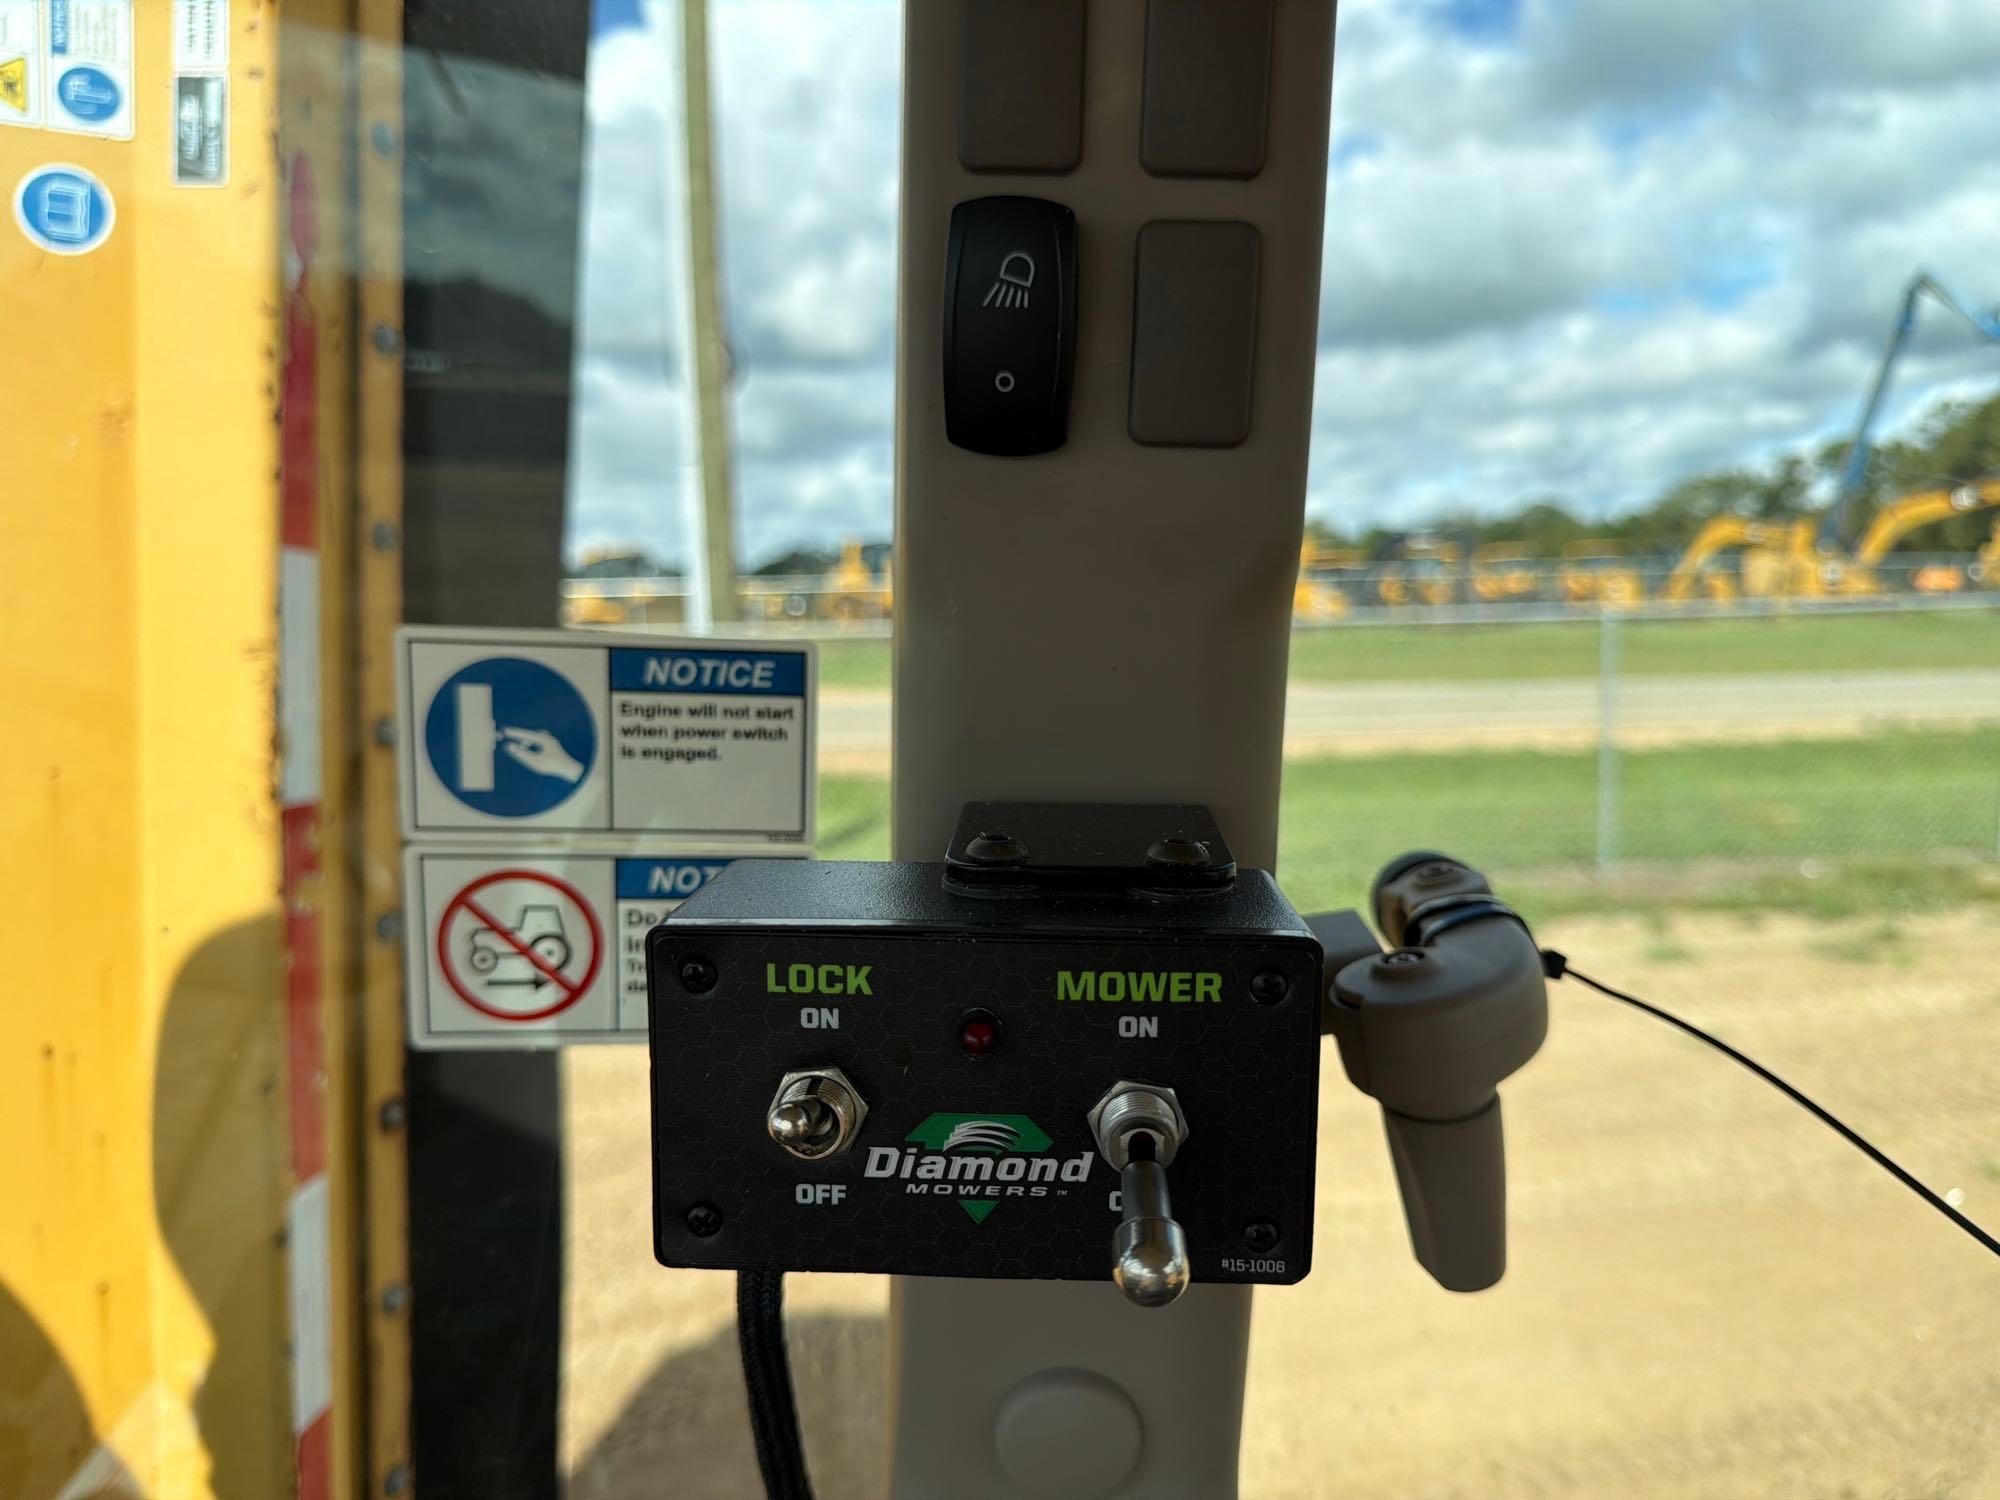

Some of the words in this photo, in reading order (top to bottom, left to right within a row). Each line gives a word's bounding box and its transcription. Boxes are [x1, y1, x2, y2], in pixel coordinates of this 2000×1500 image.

[642, 657, 776, 688] NOTICE
[621, 703, 683, 721] Engine
[688, 704, 718, 719] will
[723, 706, 750, 720] not
[756, 705, 794, 722] start
[621, 724, 669, 738] when
[673, 728, 727, 743] power
[733, 726, 788, 742] switch
[621, 745, 636, 760] is
[641, 747, 723, 764] engaged.
[766, 963, 873, 996] LOCK
[1057, 970, 1223, 1003] MOWER
[800, 1008, 840, 1030] ON
[1118, 1015, 1159, 1038] ON
[863, 1146, 1095, 1183] Diamond
[795, 1183, 847, 1205] OFF
[905, 1183, 1048, 1197] MOWERS
[1221, 1258, 1286, 1273] #15-1006
